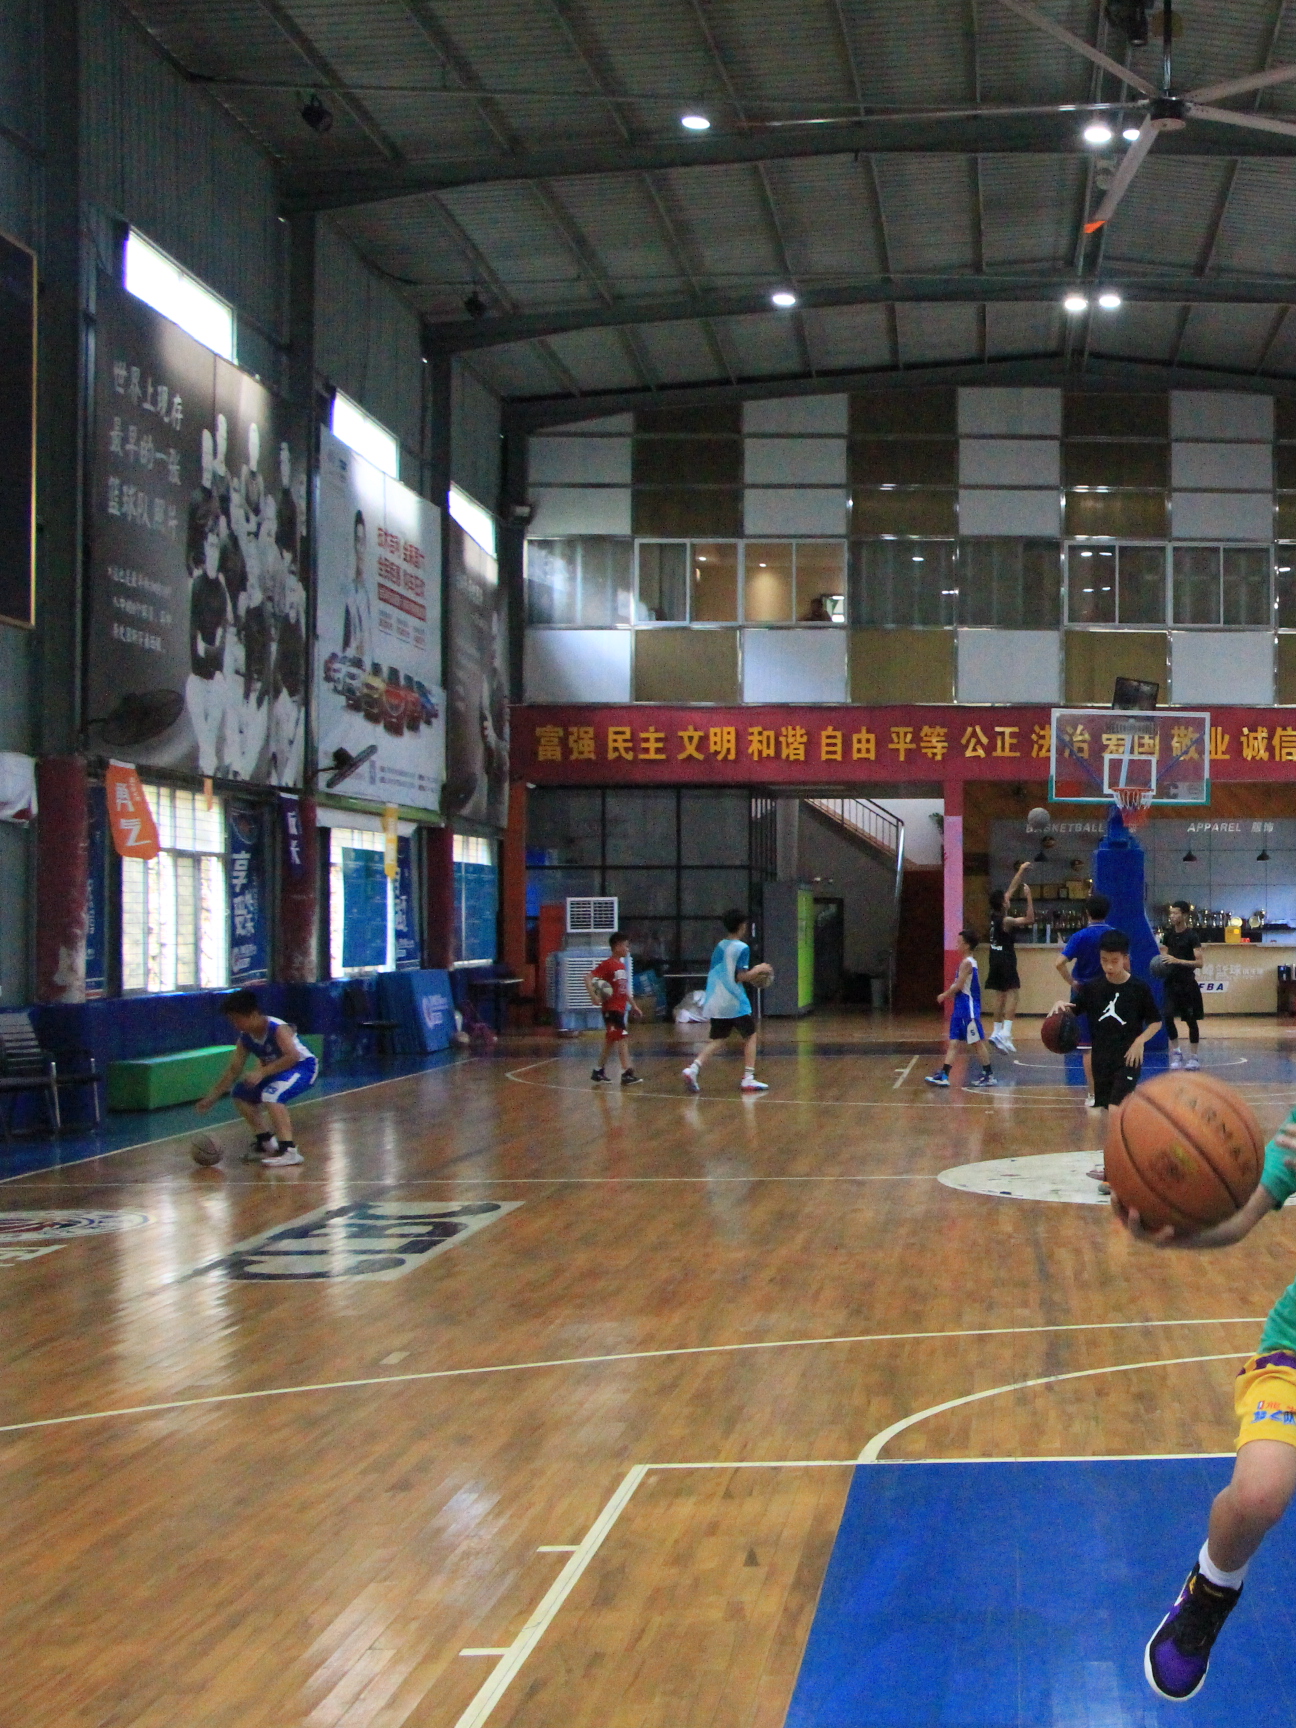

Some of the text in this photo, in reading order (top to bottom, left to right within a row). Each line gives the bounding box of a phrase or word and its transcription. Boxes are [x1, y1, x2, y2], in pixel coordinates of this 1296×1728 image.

[535, 726, 597, 761] 富强
[607, 726, 666, 761] 民主
[677, 725, 736, 761] 文明
[747, 725, 807, 761] 和谐
[821, 726, 876, 761] 自由
[888, 725, 948, 761] 平等
[960, 724, 1021, 759] 公正
[1031, 724, 1091, 760] 法治
[1171, 725, 1231, 761] 敬业
[1187, 822, 1241, 833] APPAREL
[1251, 822, 1274, 833] 服饰
